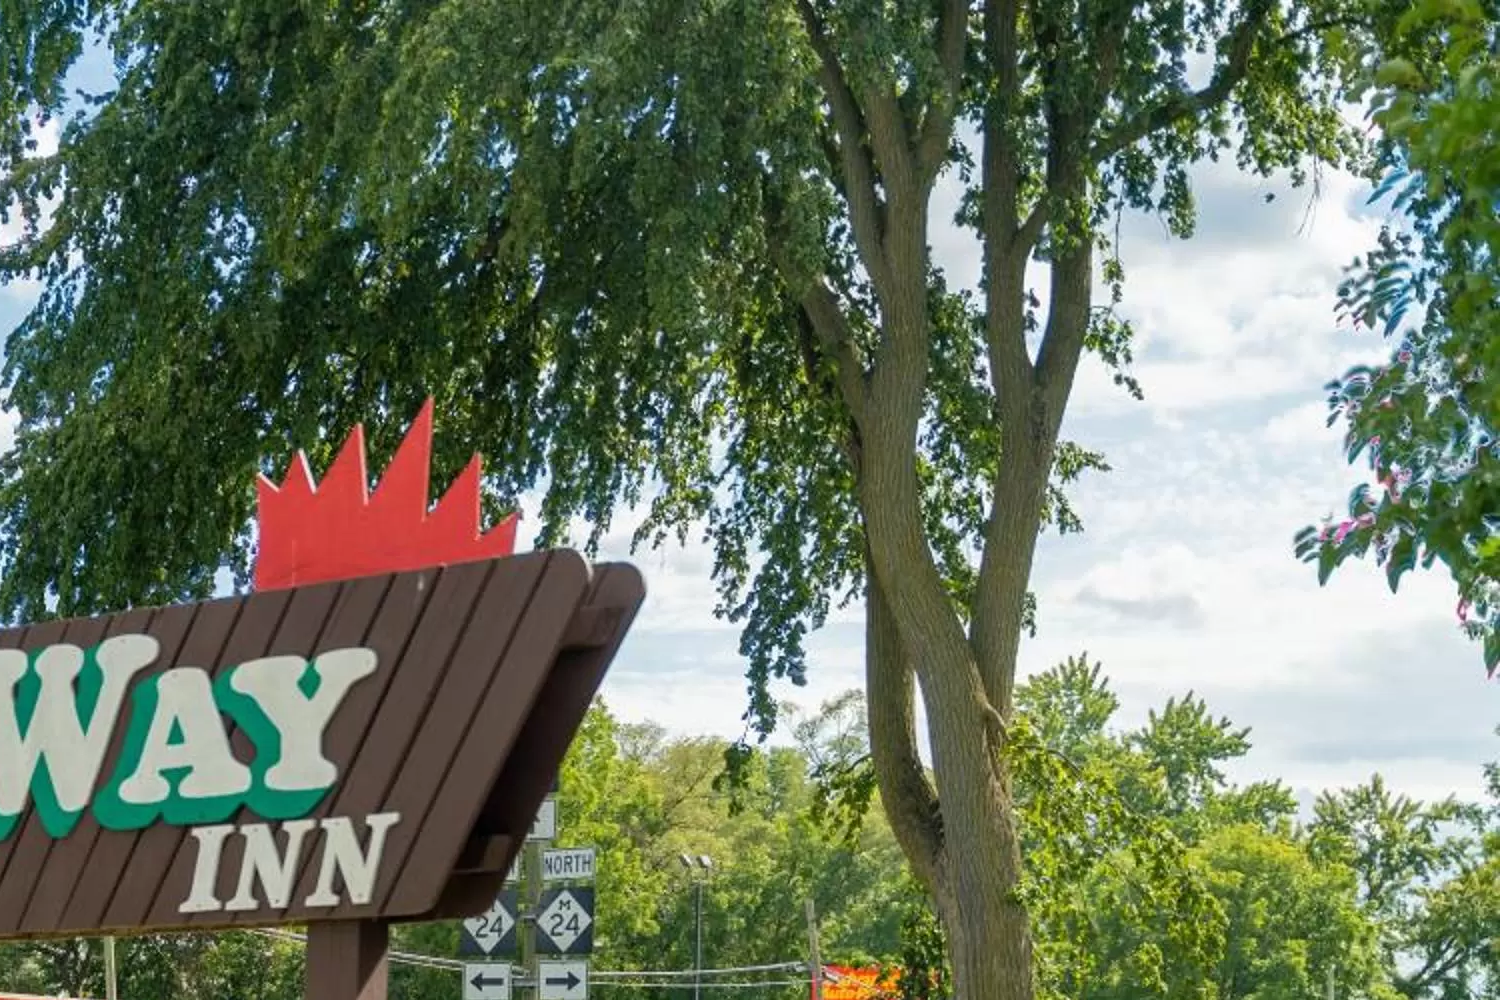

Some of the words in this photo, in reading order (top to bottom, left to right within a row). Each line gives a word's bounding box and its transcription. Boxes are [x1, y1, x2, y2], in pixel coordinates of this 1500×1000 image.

[178, 811, 401, 913] INN
[545, 854, 592, 874] NORTH
[558, 899, 572, 911] M
[475, 914, 504, 939] 24
[549, 912, 581, 937] 24
